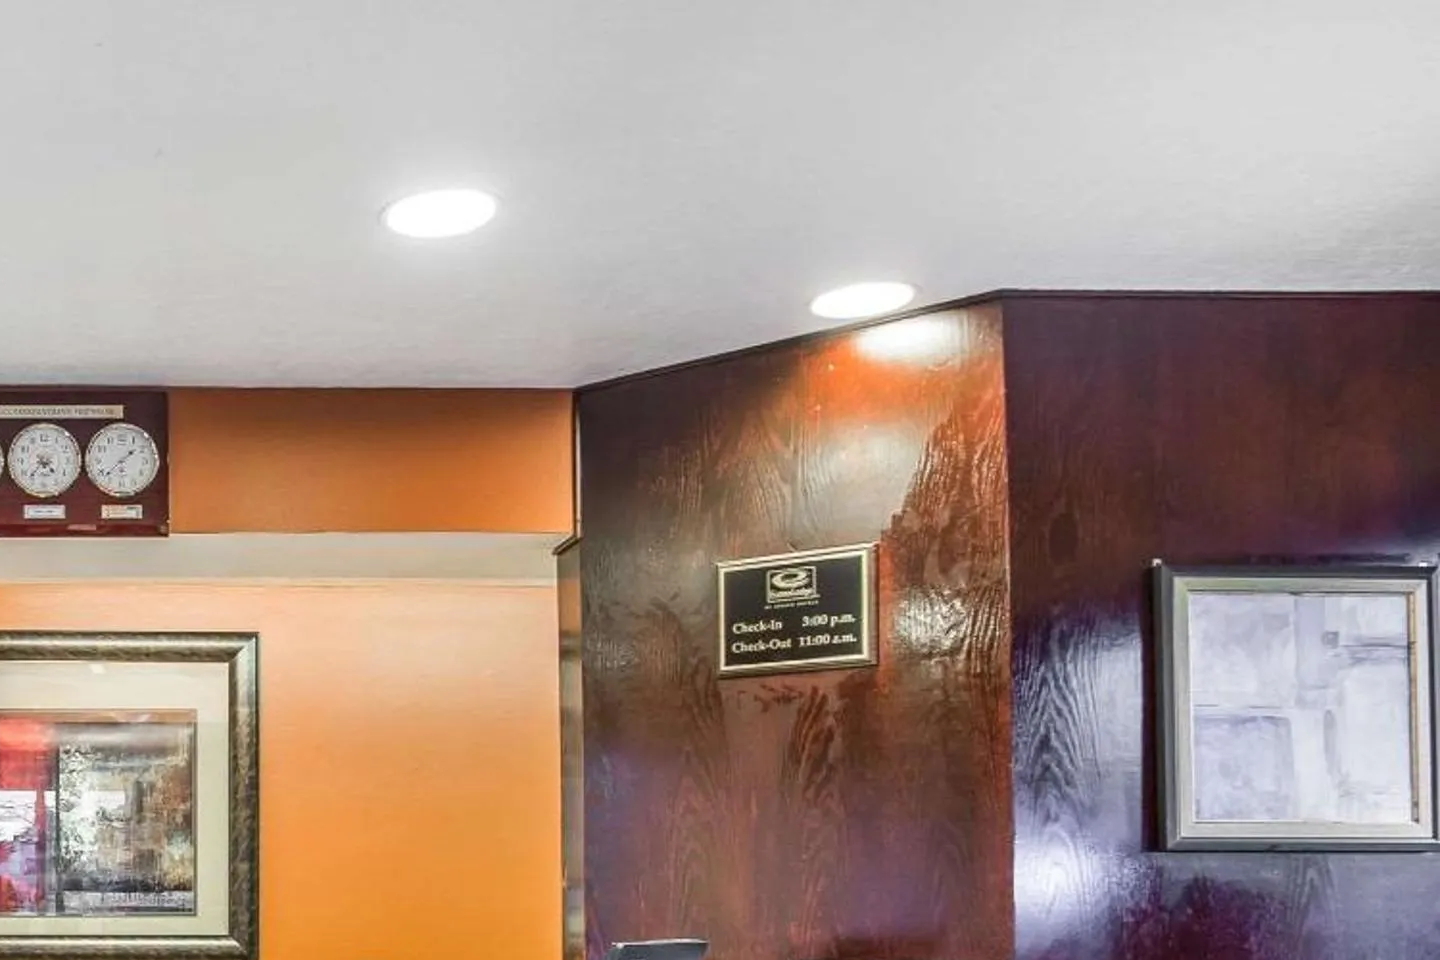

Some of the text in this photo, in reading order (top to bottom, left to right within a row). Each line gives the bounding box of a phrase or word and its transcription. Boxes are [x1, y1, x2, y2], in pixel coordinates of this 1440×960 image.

[732, 613, 857, 634] Check-In 3:00 p.m.
[732, 638, 792, 653] Check-Out
[799, 633, 831, 648] 11:00
